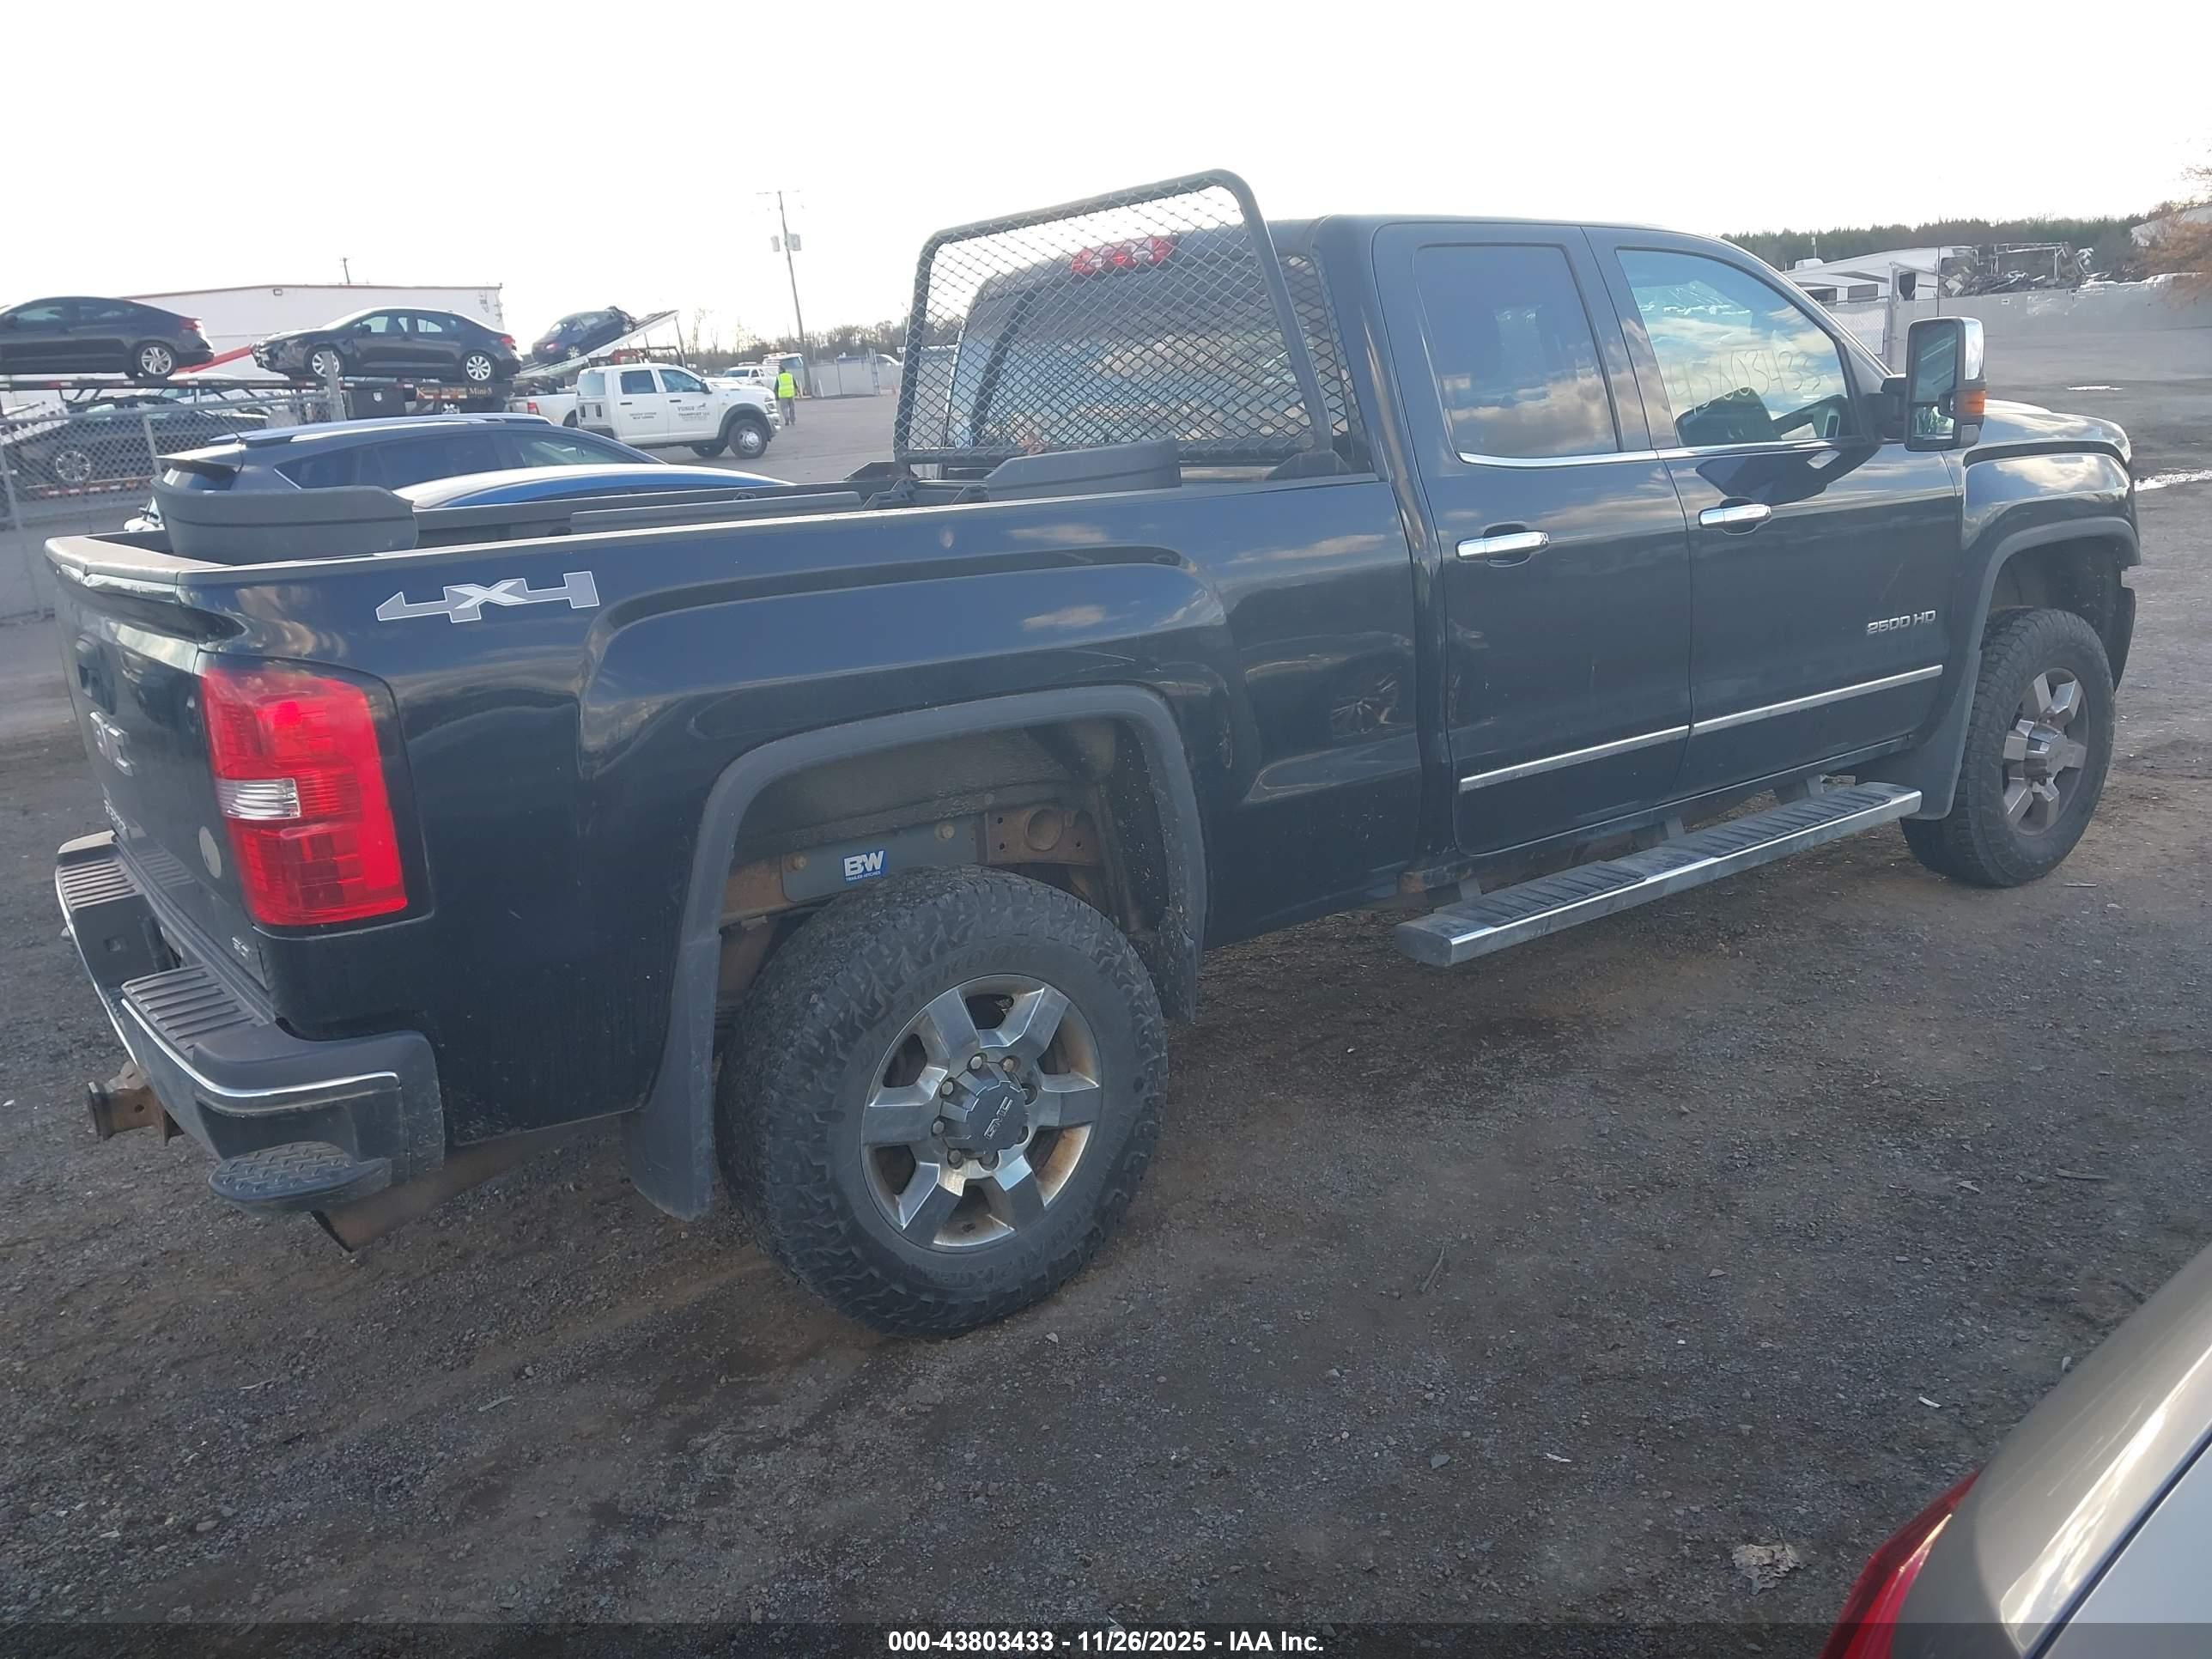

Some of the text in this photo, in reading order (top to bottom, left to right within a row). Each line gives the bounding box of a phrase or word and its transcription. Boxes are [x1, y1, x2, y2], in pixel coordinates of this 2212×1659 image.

[1867, 610, 1936, 635] 2500 HD
[983, 1096, 1013, 1140] GMC
